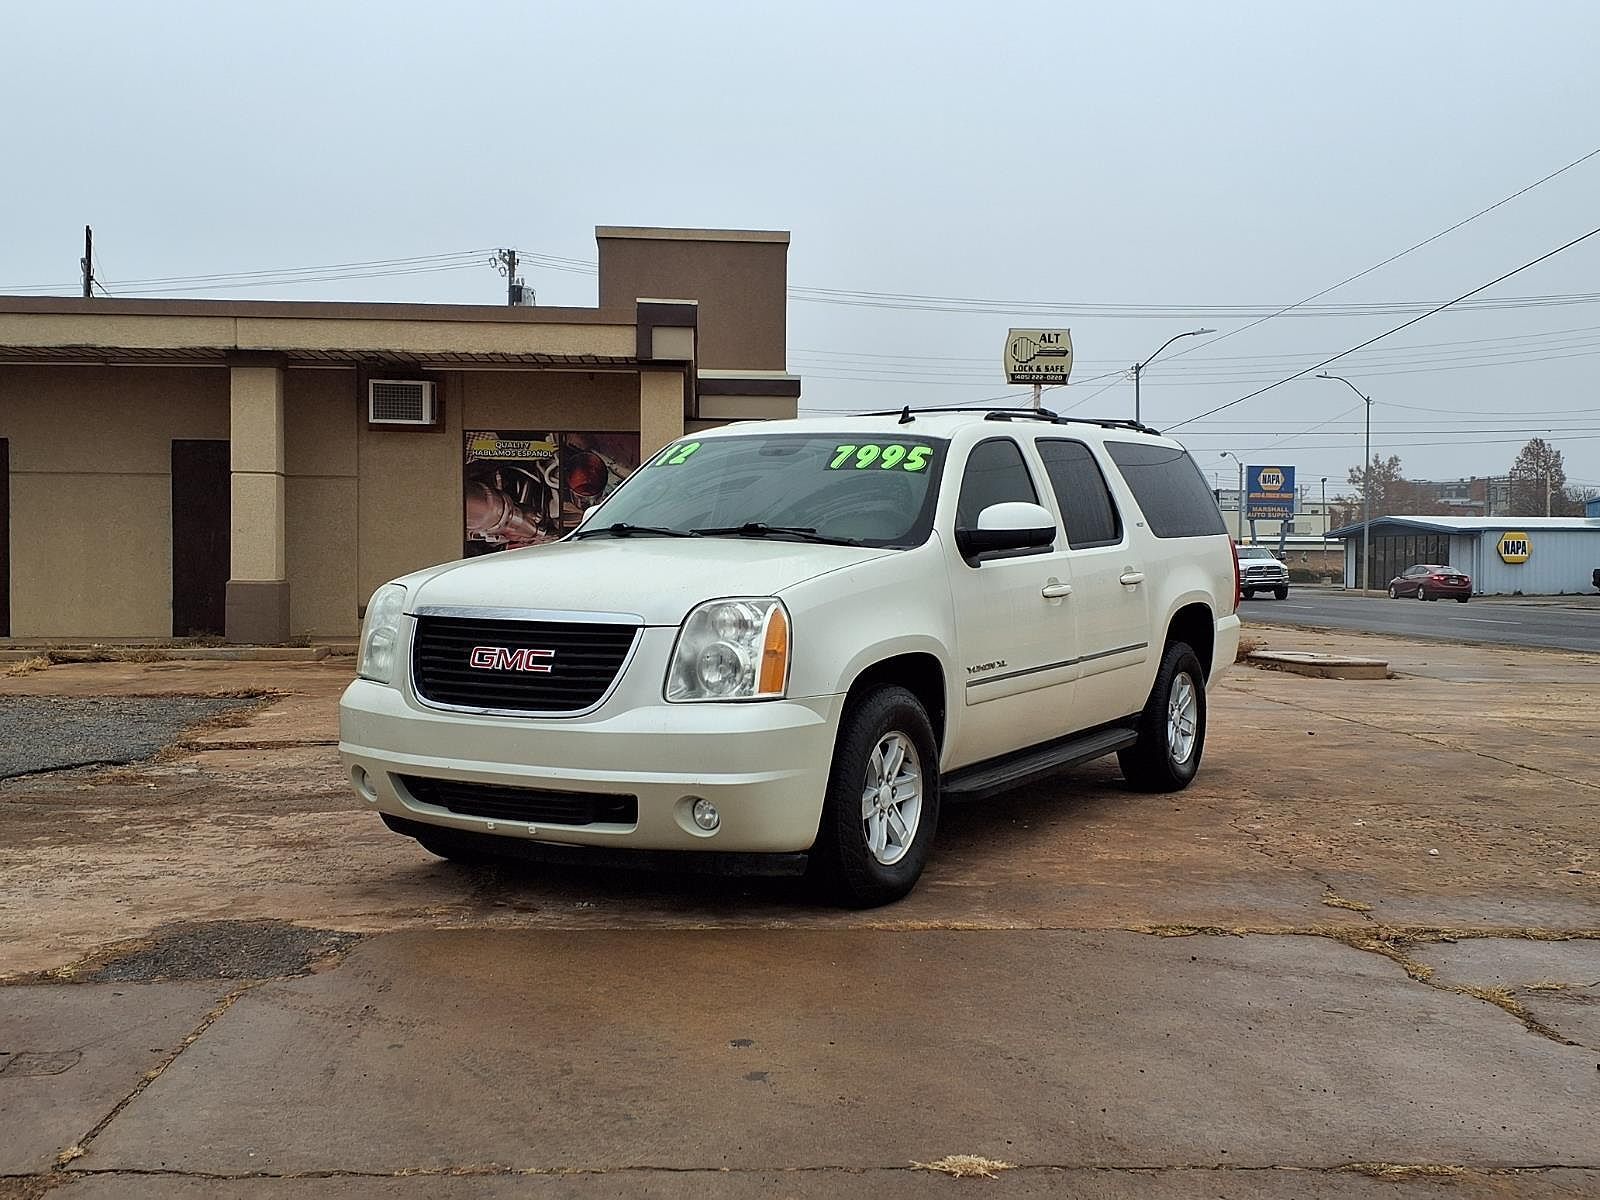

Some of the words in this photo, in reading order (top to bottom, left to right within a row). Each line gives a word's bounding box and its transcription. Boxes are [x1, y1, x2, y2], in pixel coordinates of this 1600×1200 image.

[1040, 334, 1060, 344] ALT
[1014, 364, 1034, 372] LOCK
[1036, 365, 1042, 373] &
[495, 440, 530, 449] QUALITY
[829, 443, 934, 472] 7995
[1262, 474, 1280, 484] NAPA
[1503, 540, 1527, 555] NAPA
[470, 646, 555, 673] GMC
